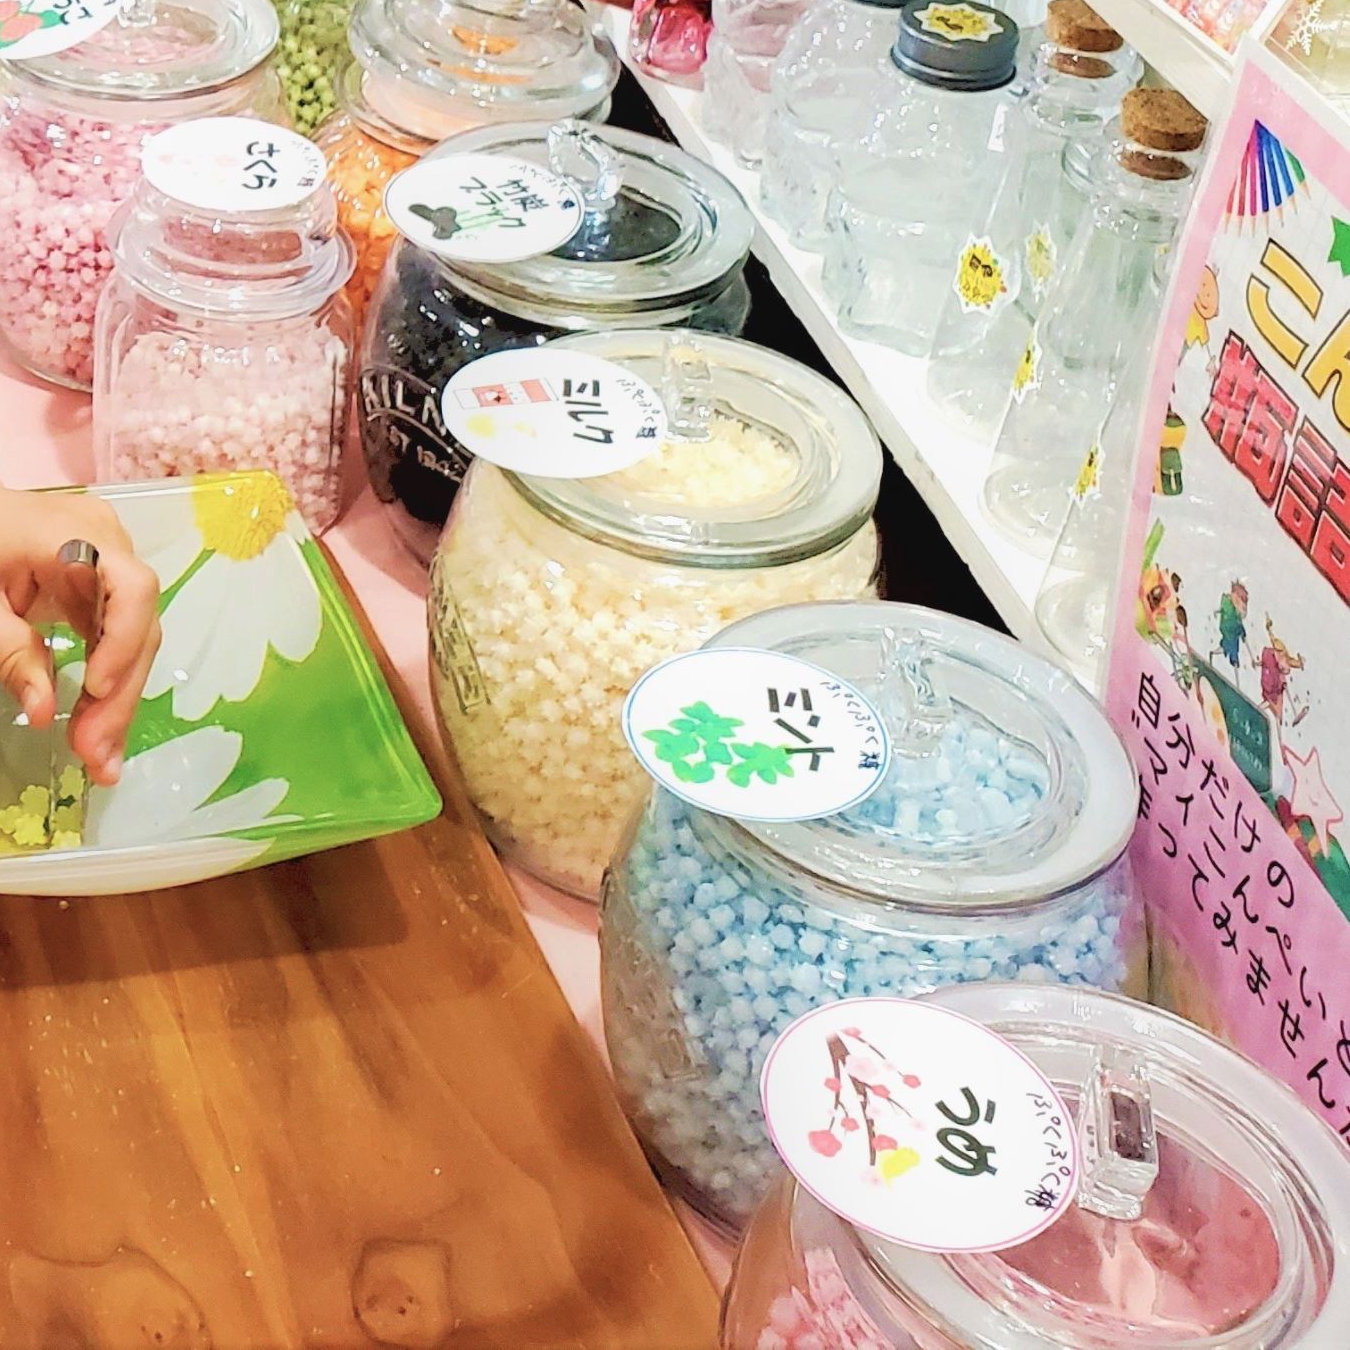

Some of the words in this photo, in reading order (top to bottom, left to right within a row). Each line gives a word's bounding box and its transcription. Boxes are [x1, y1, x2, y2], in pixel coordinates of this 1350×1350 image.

[241, 139, 283, 192] さくら
[562, 378, 616, 446] ミルク
[765, 686, 835, 773] ミント
[1138, 672, 1296, 908] 自分だけの
[934, 1085, 998, 1177] うめ
